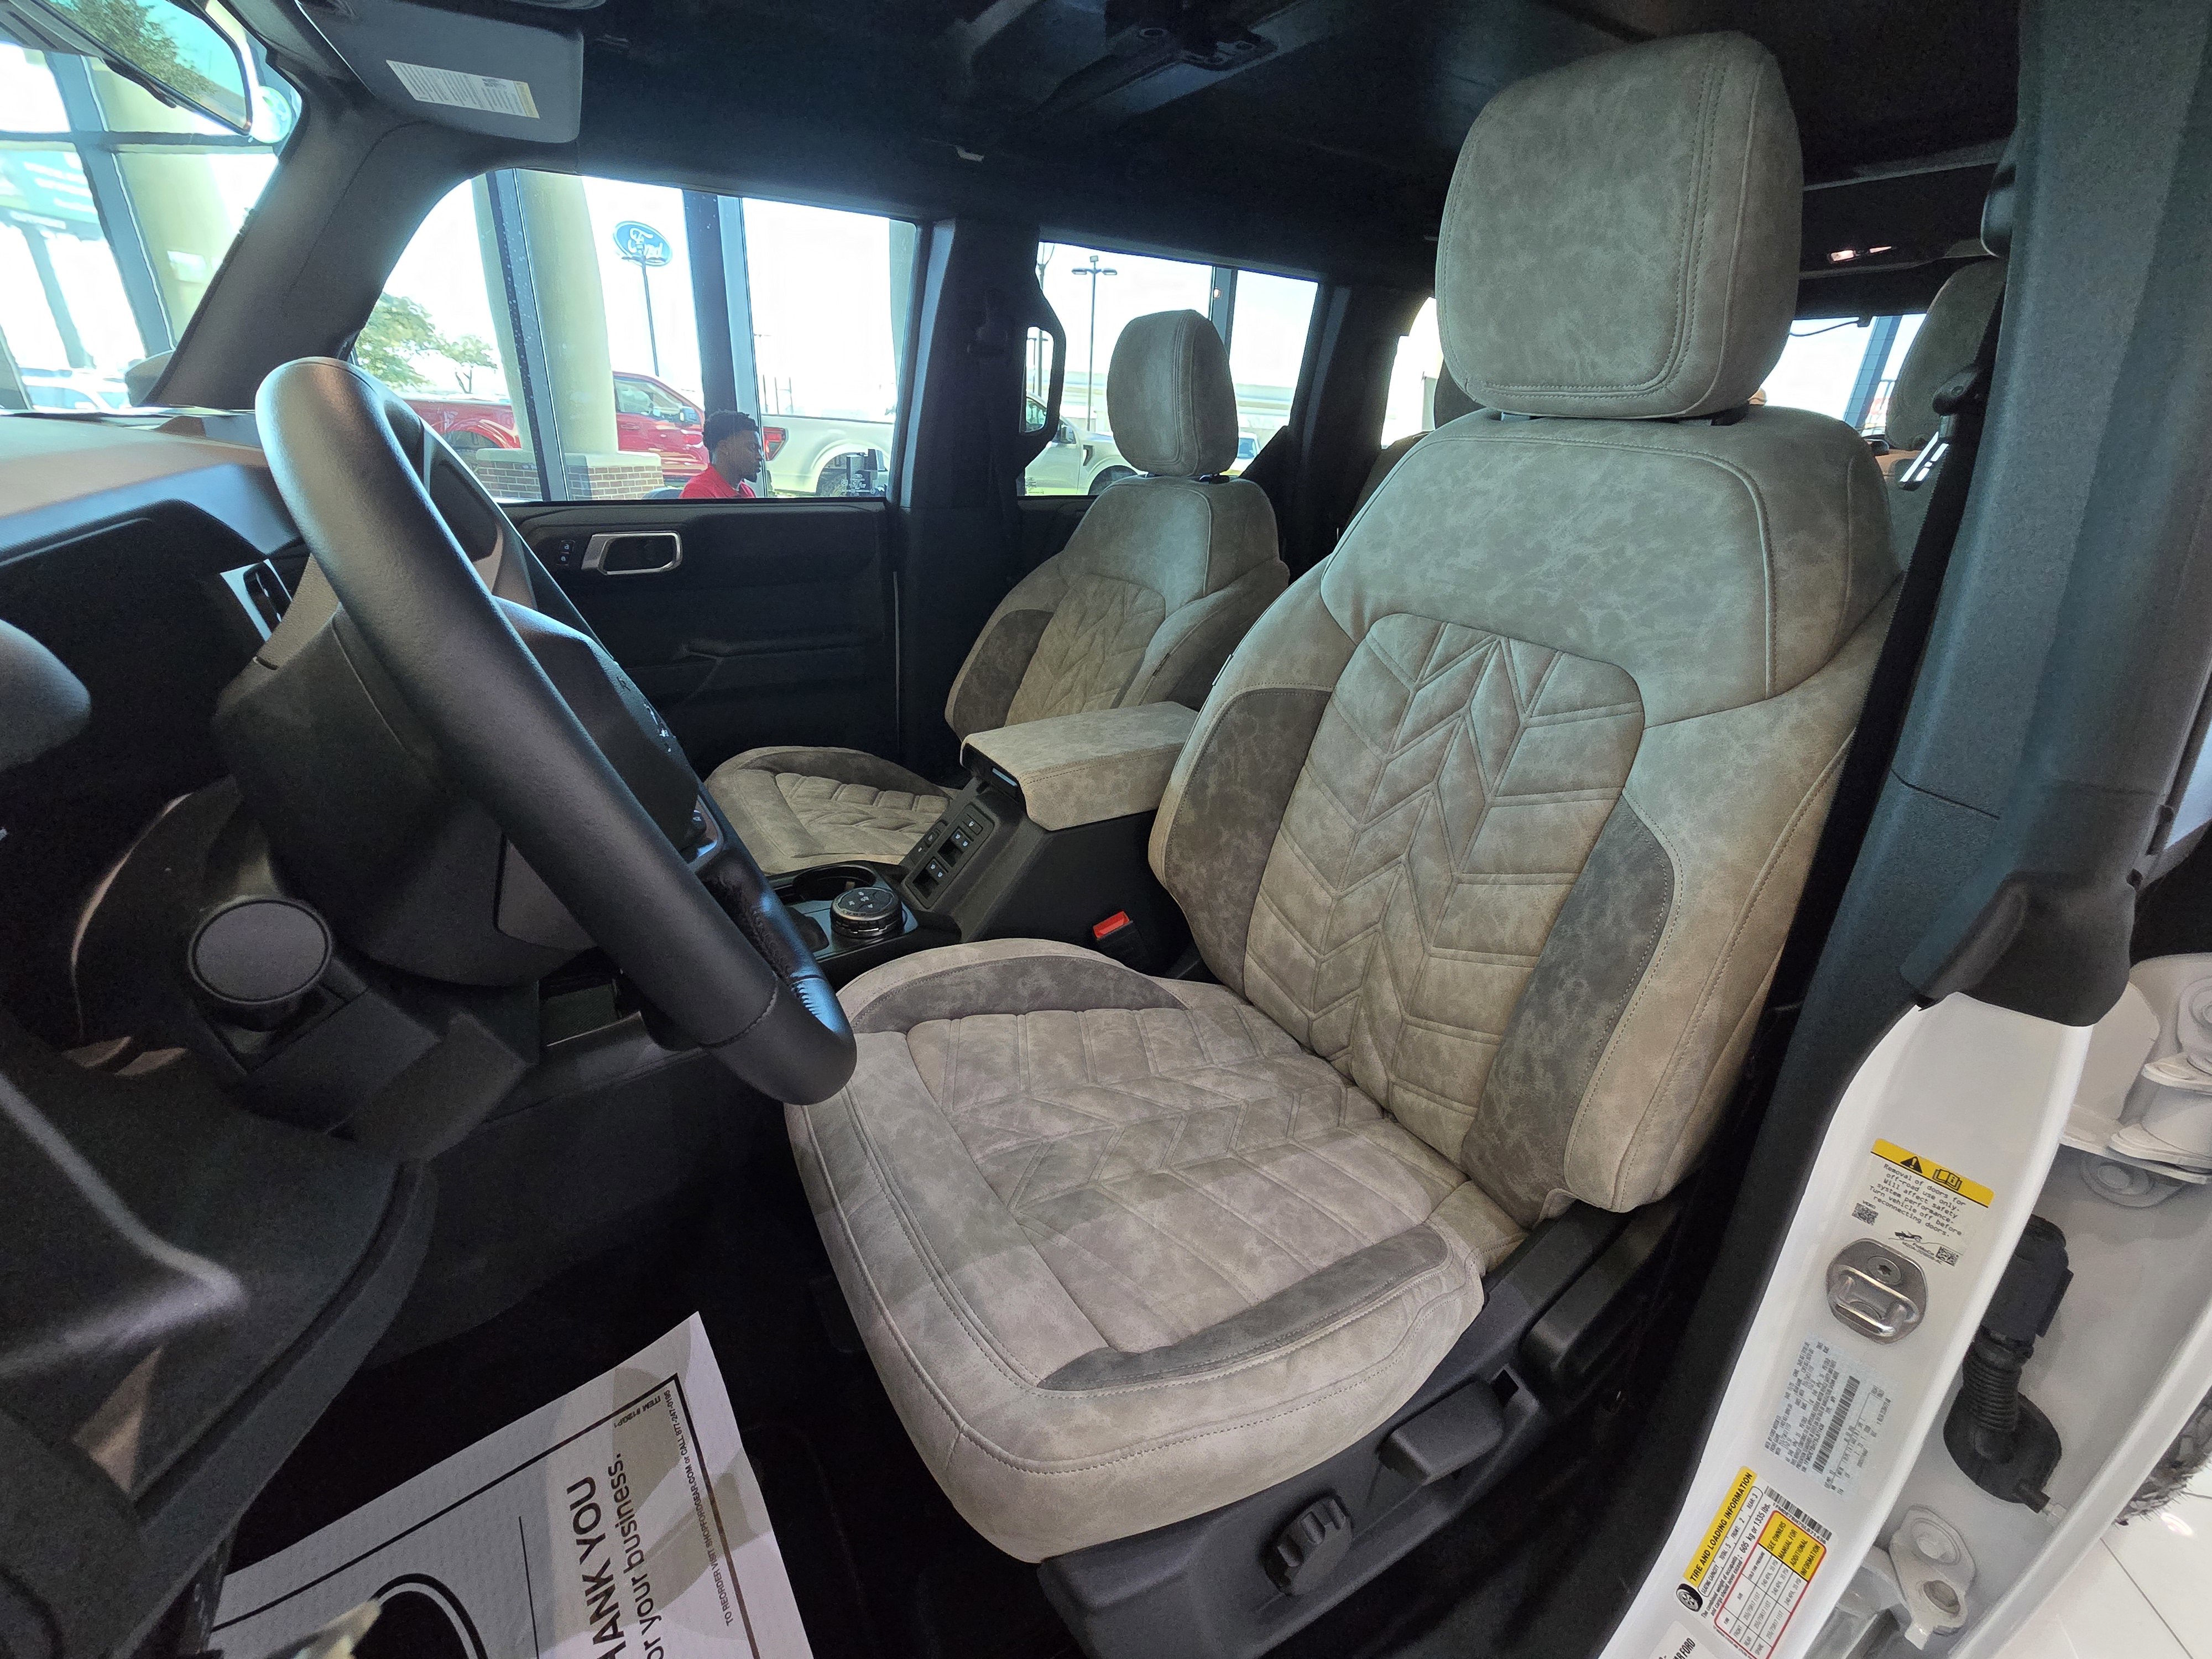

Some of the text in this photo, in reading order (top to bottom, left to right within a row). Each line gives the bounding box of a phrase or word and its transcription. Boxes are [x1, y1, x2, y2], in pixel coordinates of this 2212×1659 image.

[1877, 1183, 1954, 1223] system performance.
[1883, 1163, 1912, 1181] Removal
[1926, 1185, 1948, 1198] doors
[1952, 1197, 1966, 1206] for
[1883, 1178, 1958, 1218] Will affect safety
[1886, 1173, 1959, 1211] off-road use only.
[1870, 1185, 1961, 1235] Turn vehicle off before
[1873, 1196, 1949, 1237] reconnecting doors.
[642, 1396, 661, 1411] ITEM
[677, 1434, 687, 1455] CALL
[566, 1477, 606, 1564] YOU
[607, 1452, 645, 1574] business.
[685, 1464, 713, 1548] SHOPFORDGEAR.COM
[1689, 1472, 1752, 1581] TIRE AND LOADING INFORMATION
[1739, 1540, 1749, 1553] 605
[1745, 1532, 1755, 1541] kg
[1753, 1511, 1765, 1526] 1335
[1760, 1503, 1771, 1514] lbs.
[1767, 1521, 1786, 1551] SEE OWNERS
[1777, 1528, 1797, 1559] MANUAL FOR
[707, 1548, 718, 1571] VISIT
[1789, 1538, 1808, 1567] ADDITIONAL
[1799, 1543, 1820, 1577] INFORMATION
[713, 1568, 730, 1611] REORDER
[1708, 1564, 1719, 1581] CAPACITY
[631, 1573, 662, 1635] your
[724, 1611, 733, 1626] TO
[1705, 1591, 1718, 1611] combined
[1679, 1637, 1695, 1657] FORD
